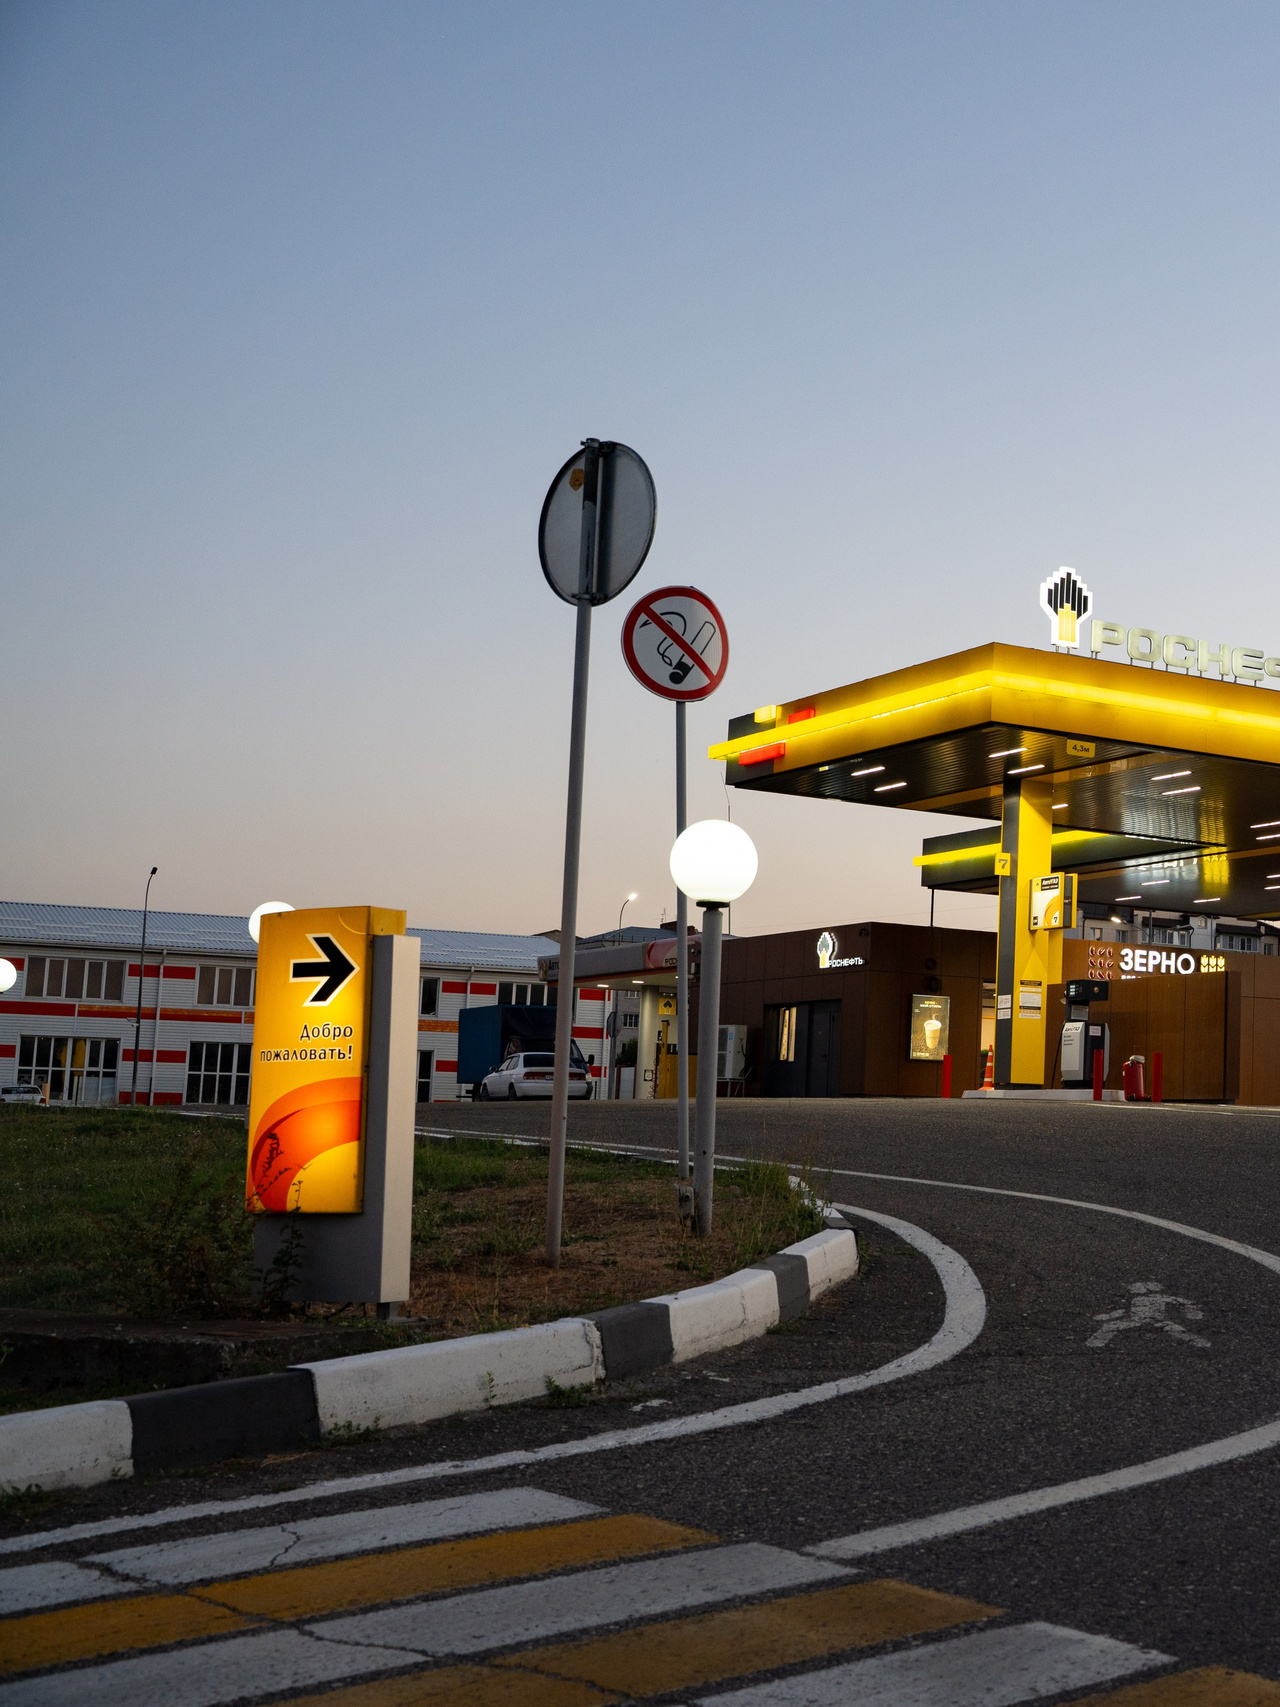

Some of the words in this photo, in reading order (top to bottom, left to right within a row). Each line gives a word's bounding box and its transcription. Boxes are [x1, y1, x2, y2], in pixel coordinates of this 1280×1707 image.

[998, 858, 1009, 869] 7
[829, 957, 863, 968] РОСНЕФТЬ
[1120, 948, 1196, 975] ЗЕРНО
[300, 1023, 354, 1041] Добро
[260, 1045, 352, 1062] пожаловать!
